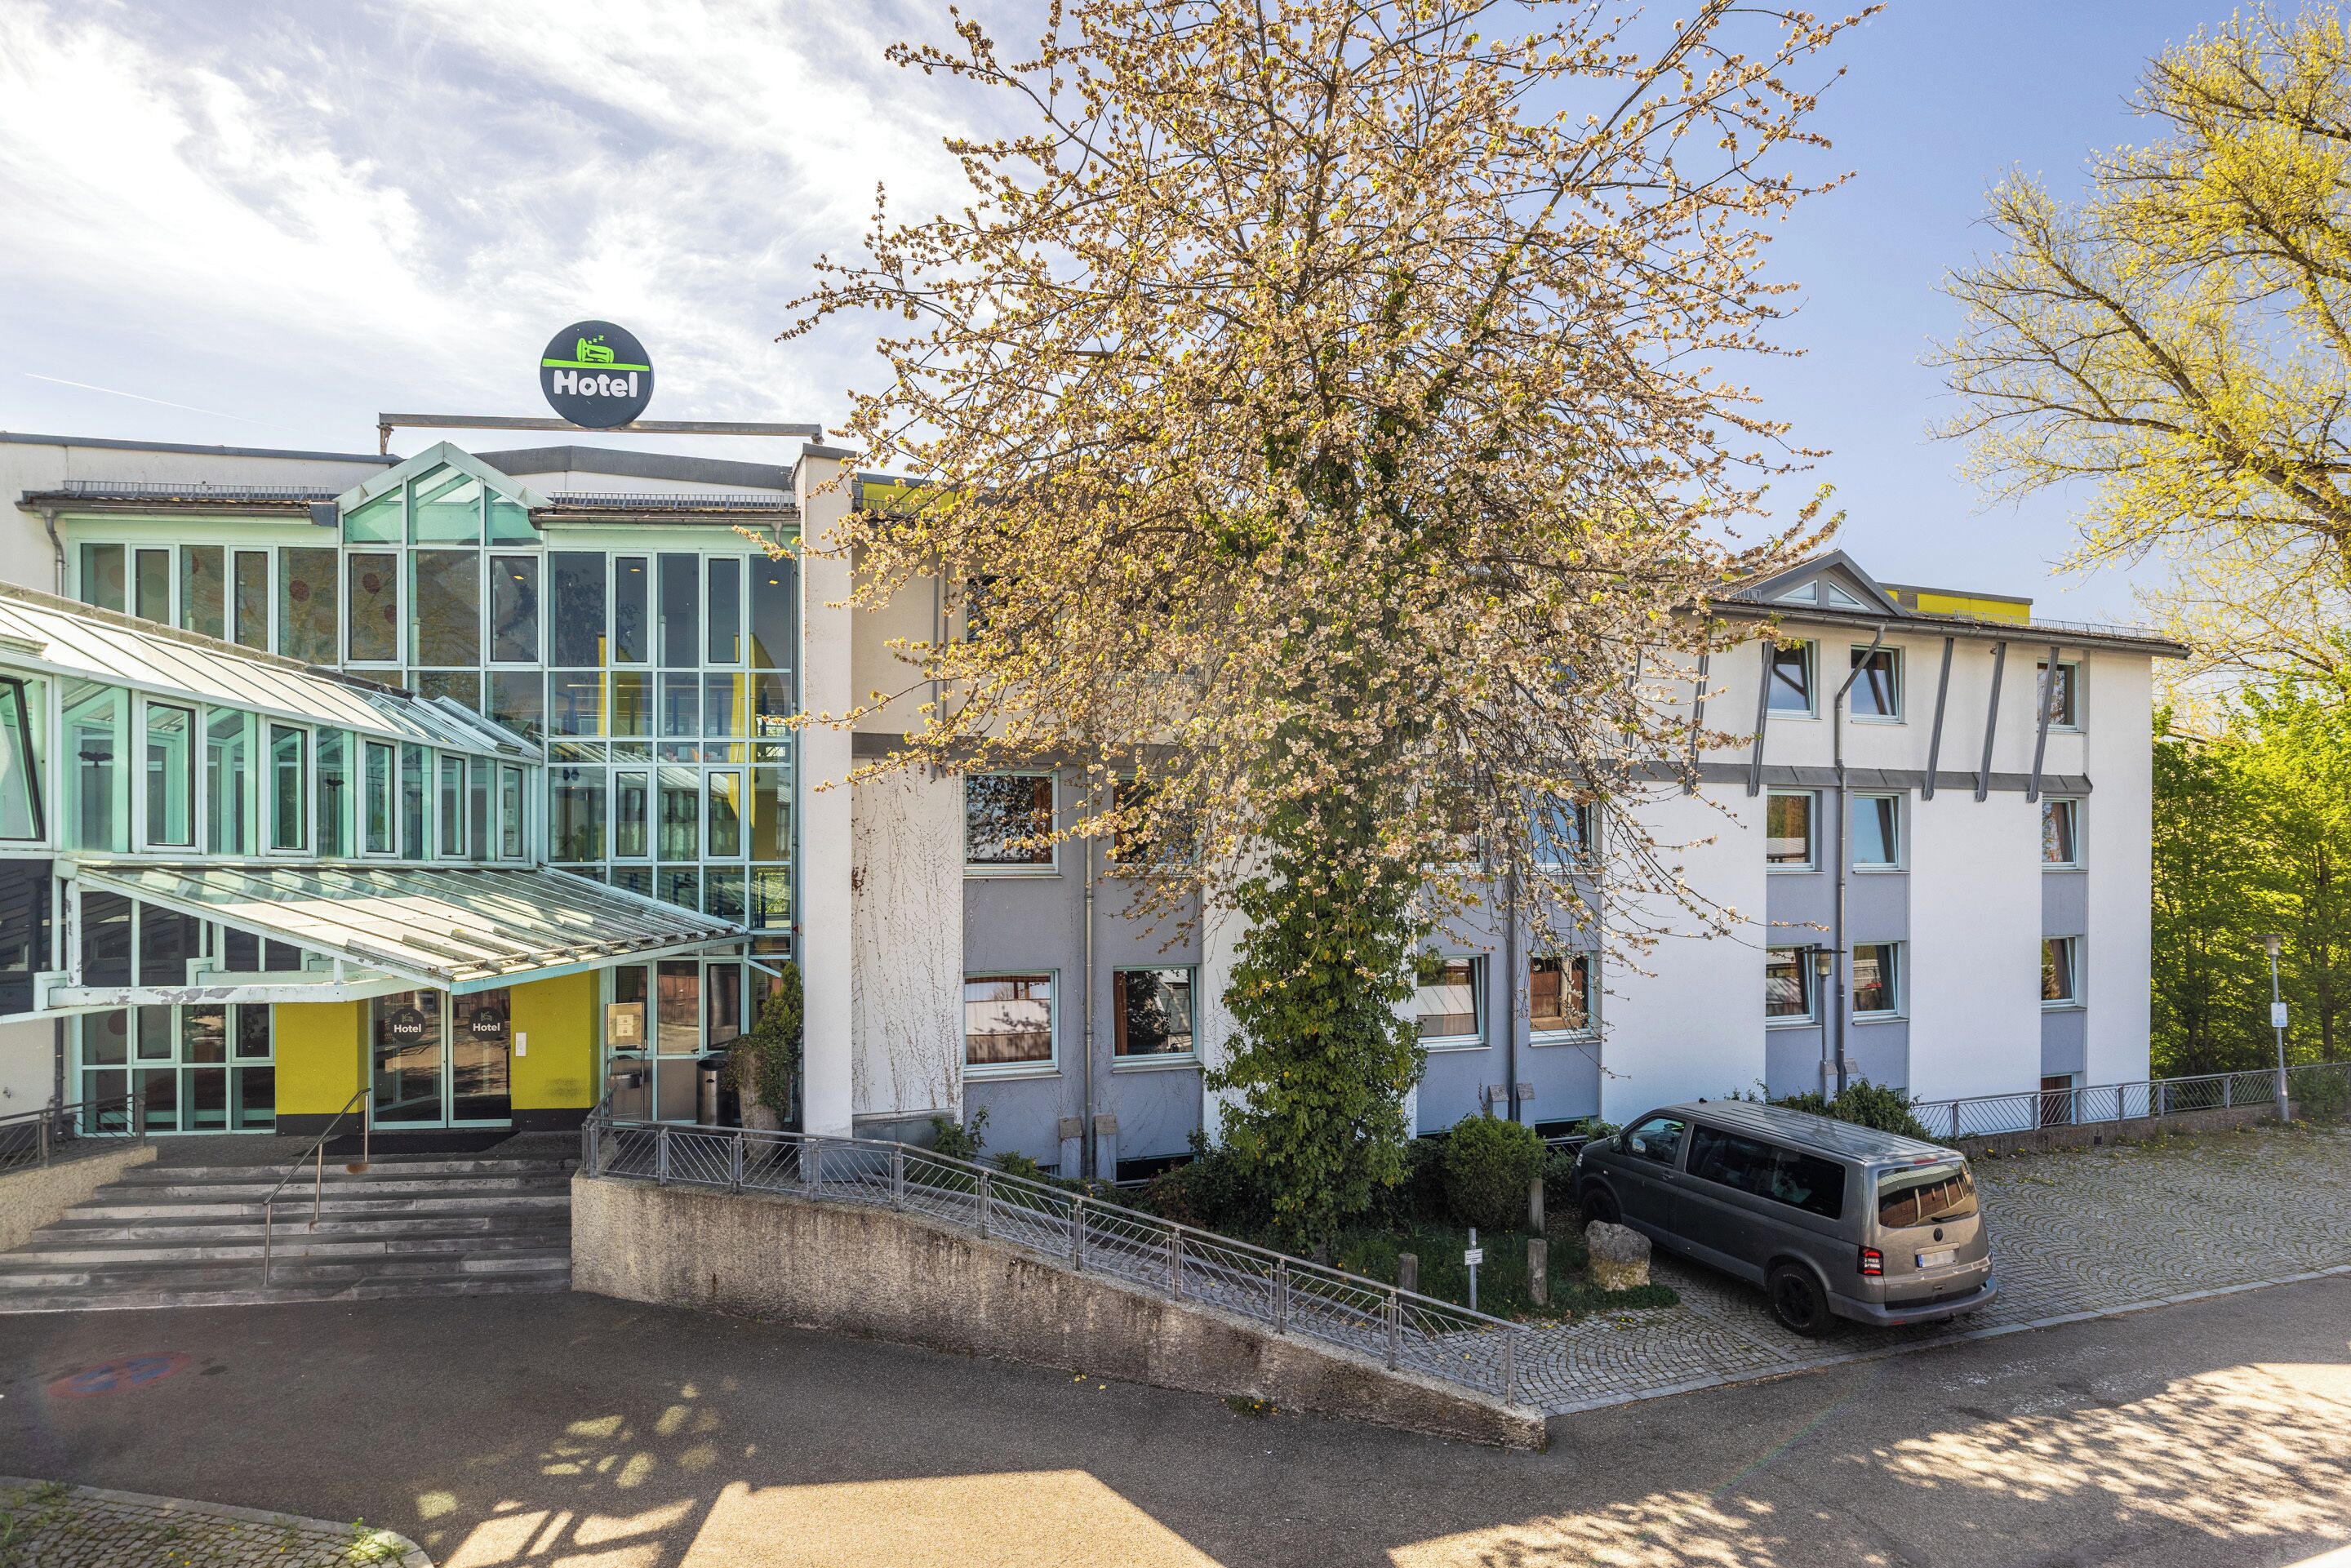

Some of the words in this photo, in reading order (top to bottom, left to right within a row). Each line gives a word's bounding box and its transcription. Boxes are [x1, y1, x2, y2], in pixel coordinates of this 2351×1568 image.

[553, 370, 638, 398] Hotel
[393, 1024, 422, 1033] Hotel
[473, 1022, 500, 1032] Hotel
